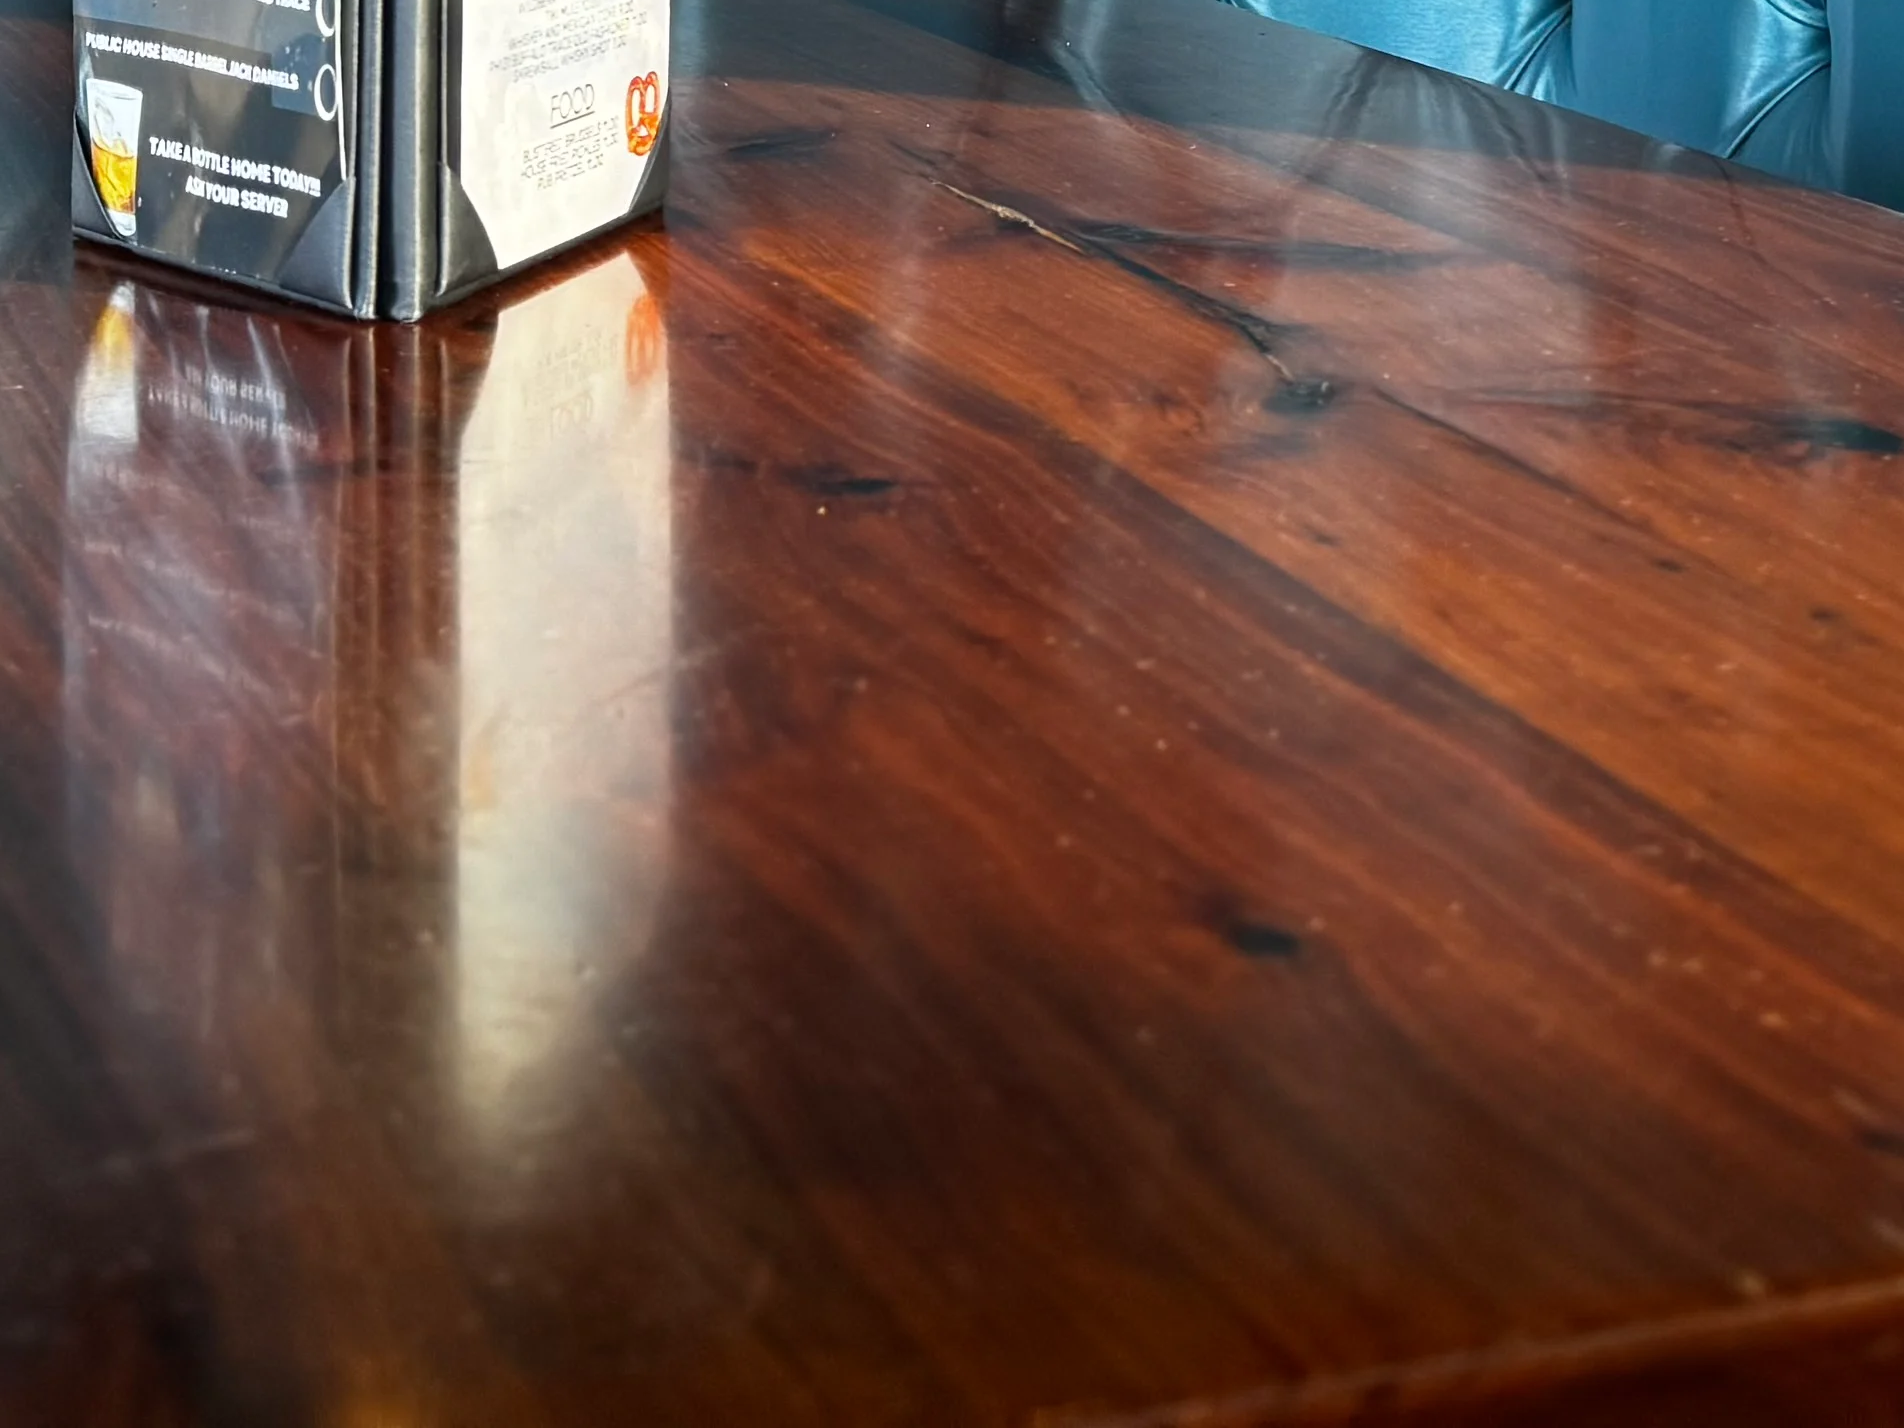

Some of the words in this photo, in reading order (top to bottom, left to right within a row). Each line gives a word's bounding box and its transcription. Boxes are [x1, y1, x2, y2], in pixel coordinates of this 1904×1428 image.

[86, 31, 122, 54] PUBLIC
[122, 37, 160, 60] HOUSE
[160, 42, 194, 67] SINGLE
[229, 60, 252, 82] JACK
[252, 65, 300, 91] DANIELS
[550, 83, 595, 123] FOOD
[149, 136, 183, 161] TAKE
[182, 144, 191, 163] A
[191, 146, 229, 175] BOTTLE
[230, 157, 272, 184] HOME
[185, 174, 205, 197] ASK
[204, 182, 240, 207] YOUR
[240, 189, 289, 218] SERVER
